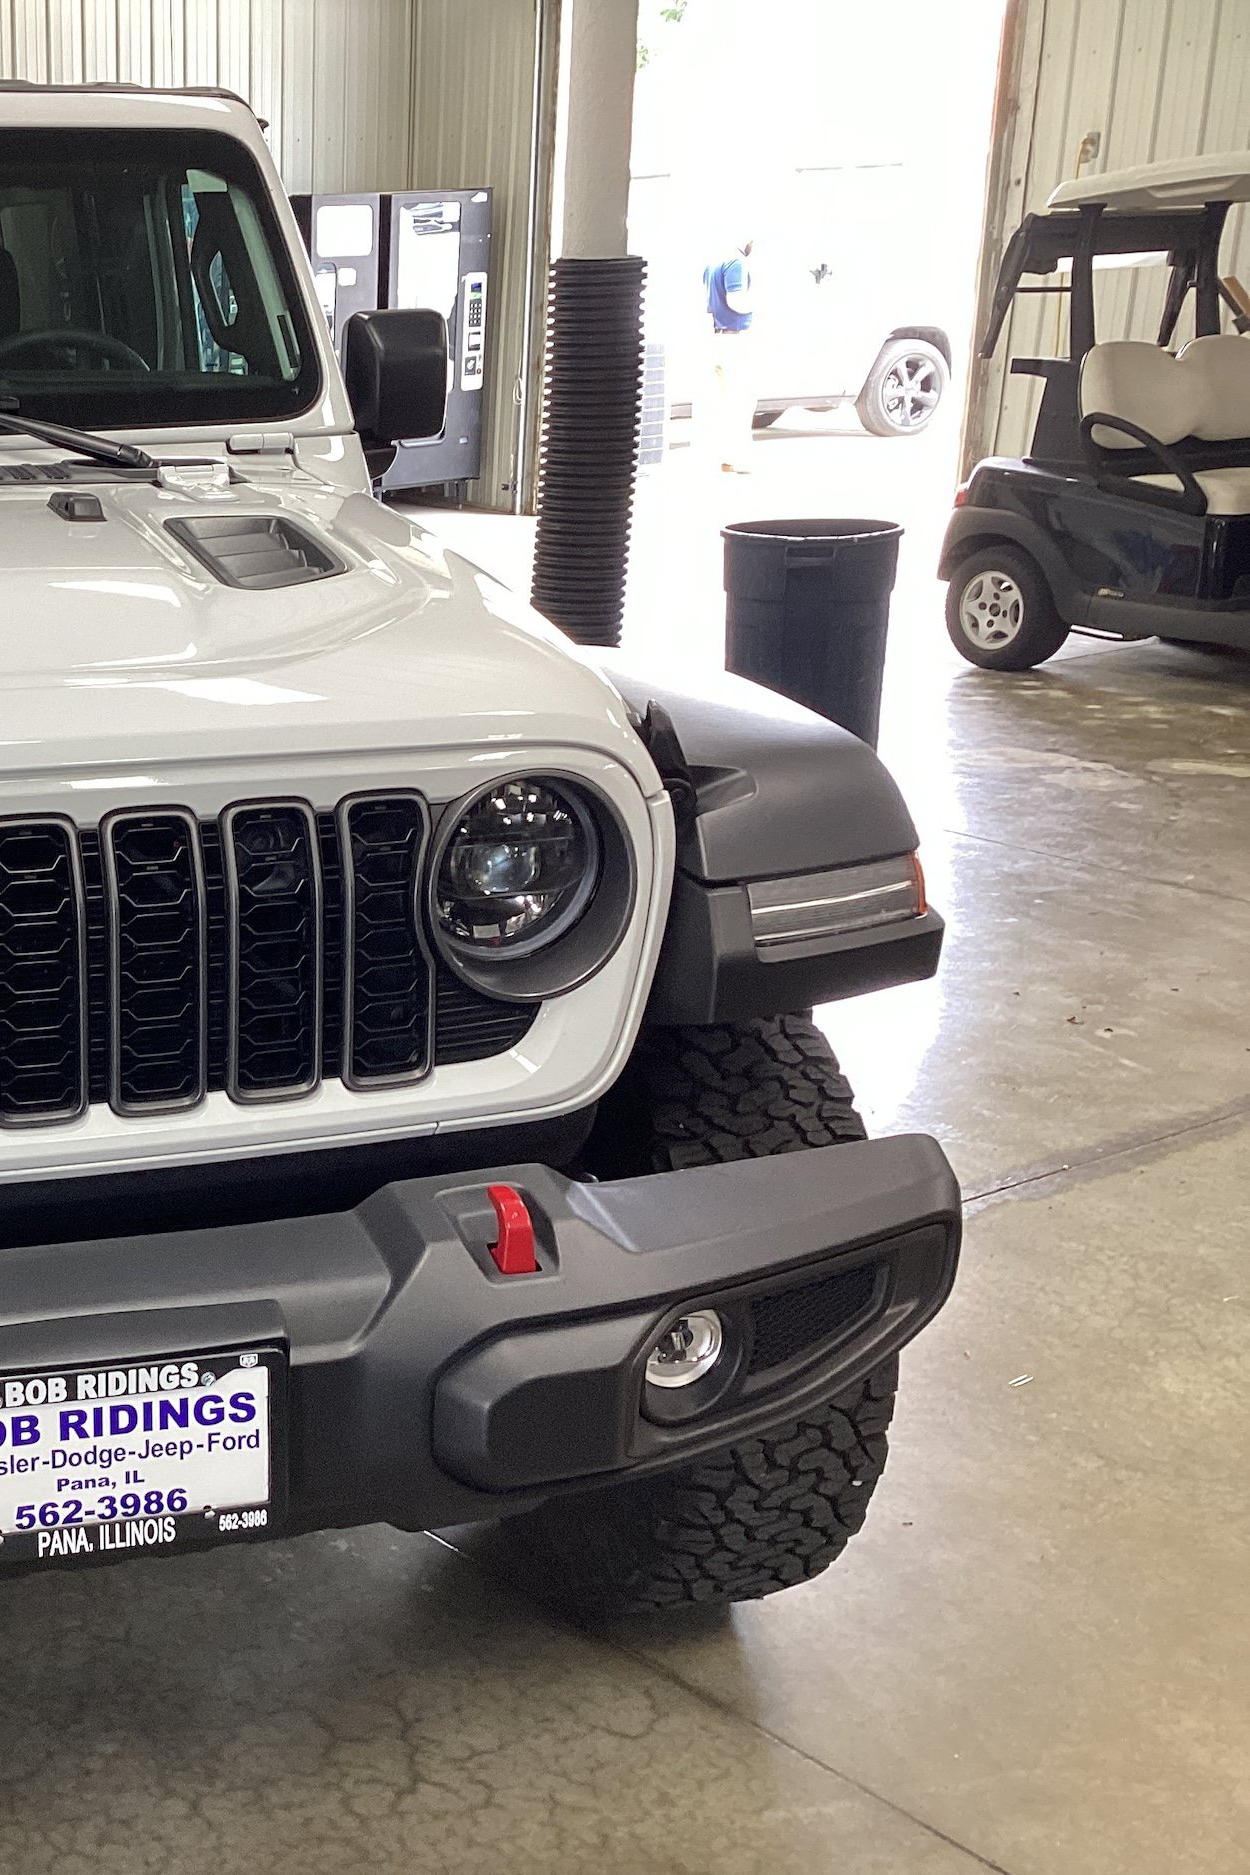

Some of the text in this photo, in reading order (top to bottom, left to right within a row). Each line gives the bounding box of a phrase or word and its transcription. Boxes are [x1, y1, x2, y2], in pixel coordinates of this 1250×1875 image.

[5, 1362, 199, 1408] BOB RIDINGS
[59, 1392, 256, 1442] RIDINGS
[57, 1470, 145, 1492] Pana, IL
[15, 1488, 188, 1530] 562-3986
[218, 1509, 268, 1532] 562-3986
[38, 1516, 176, 1558] PANA, ILLINOIS
